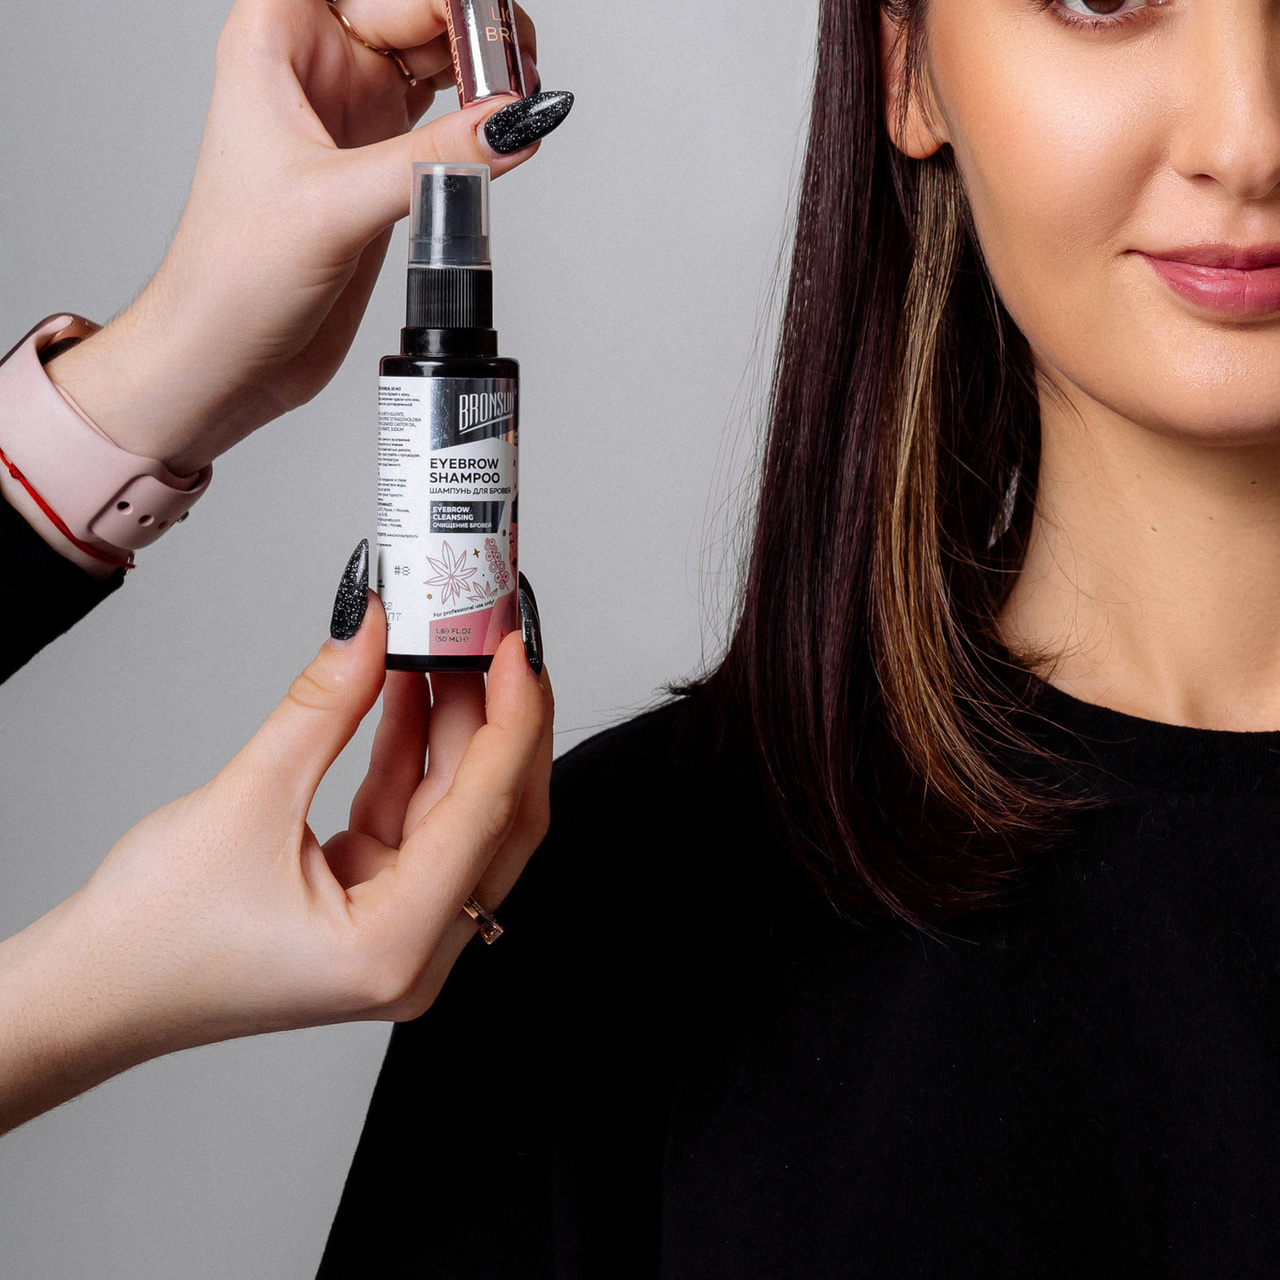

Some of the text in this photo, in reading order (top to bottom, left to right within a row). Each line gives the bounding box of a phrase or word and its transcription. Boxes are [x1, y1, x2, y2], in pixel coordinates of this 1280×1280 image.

[459, 391, 515, 431] BRONSUN
[430, 458, 499, 470] EYEBROW
[429, 472, 501, 484] SHAMPOO
[429, 485, 513, 496] ШАМПУНЬ ДЛЯ БРОВЕЙ
[443, 604, 474, 617] professional
